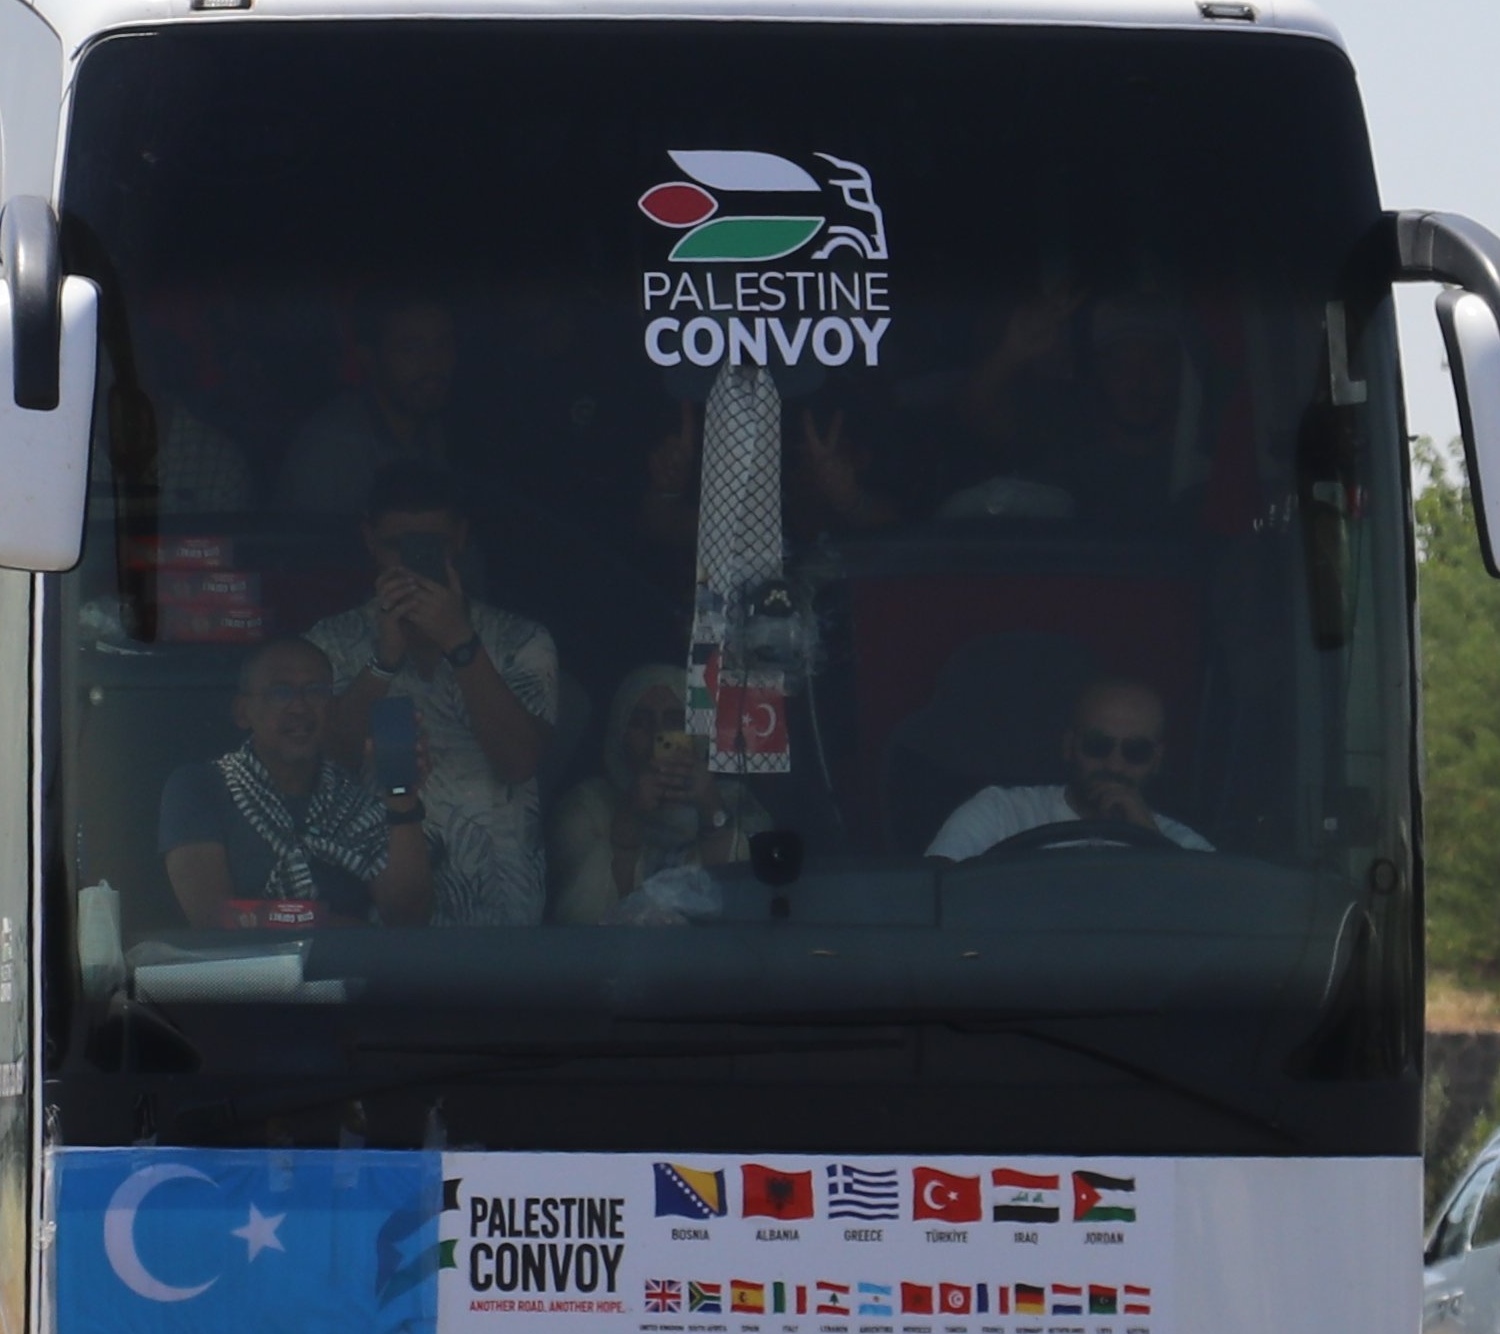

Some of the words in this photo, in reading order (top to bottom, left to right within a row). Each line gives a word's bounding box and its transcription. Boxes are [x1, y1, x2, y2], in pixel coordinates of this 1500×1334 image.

[644, 272, 889, 311] PALESTINE
[645, 317, 891, 366] CONVOY
[471, 1197, 624, 1238] PALESTINE
[671, 1228, 710, 1241] BOSNIA
[755, 1229, 800, 1242] ALBANIA
[843, 1228, 883, 1242] GREECE
[925, 1229, 968, 1244] TÜRKİYE
[1013, 1231, 1039, 1245] IRAQ
[1083, 1231, 1124, 1245] JORDAN
[470, 1243, 624, 1293] CONVOY
[469, 1299, 516, 1313] ANOTHER
[517, 1299, 547, 1313] ROAD.
[548, 1300, 595, 1313] ANOTHER
[595, 1300, 626, 1314] HOPE.
